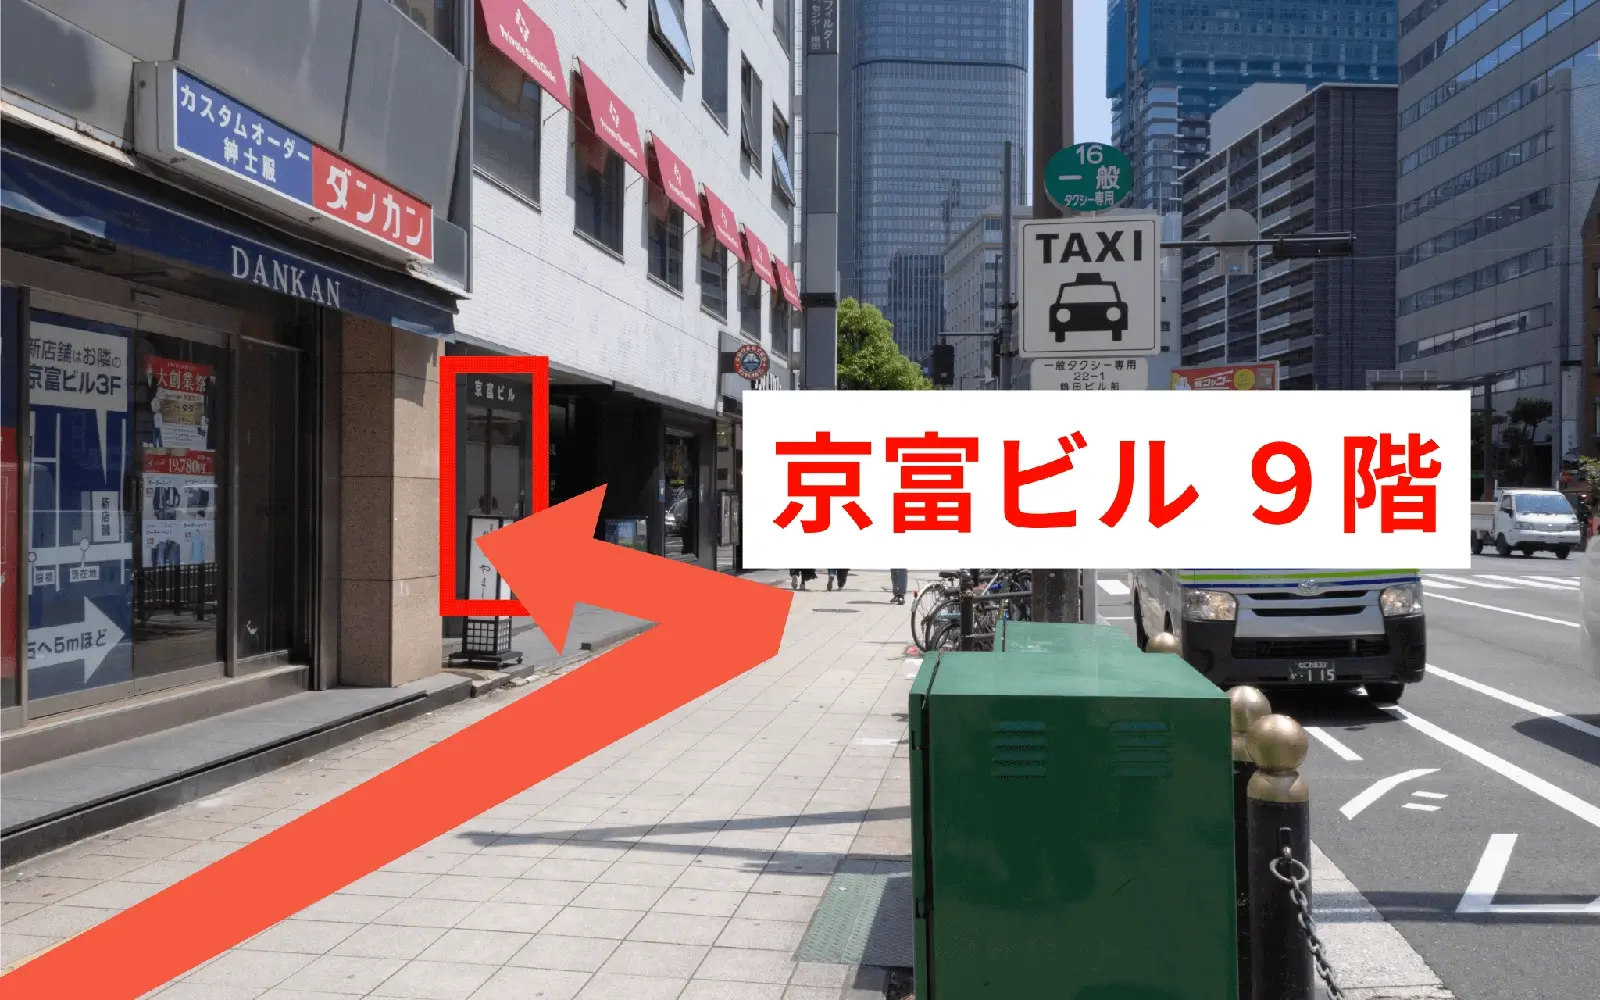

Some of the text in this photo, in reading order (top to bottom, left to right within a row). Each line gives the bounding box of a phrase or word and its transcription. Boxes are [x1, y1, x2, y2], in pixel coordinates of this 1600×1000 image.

[179, 83, 310, 162] カスタムオーダー
[223, 136, 277, 184] 紳士服
[1075, 144, 1103, 165] 16
[1058, 165, 1121, 190] 一般
[326, 164, 425, 246] ダンカン
[1063, 191, 1115, 207] タクシー専用
[1035, 230, 1143, 264] TAXI
[231, 245, 341, 309] DANKAN
[29, 363, 122, 396] 京富ビル3F
[1044, 359, 1137, 371] 一般タクシー専用
[473, 379, 516, 403] 京富ビル
